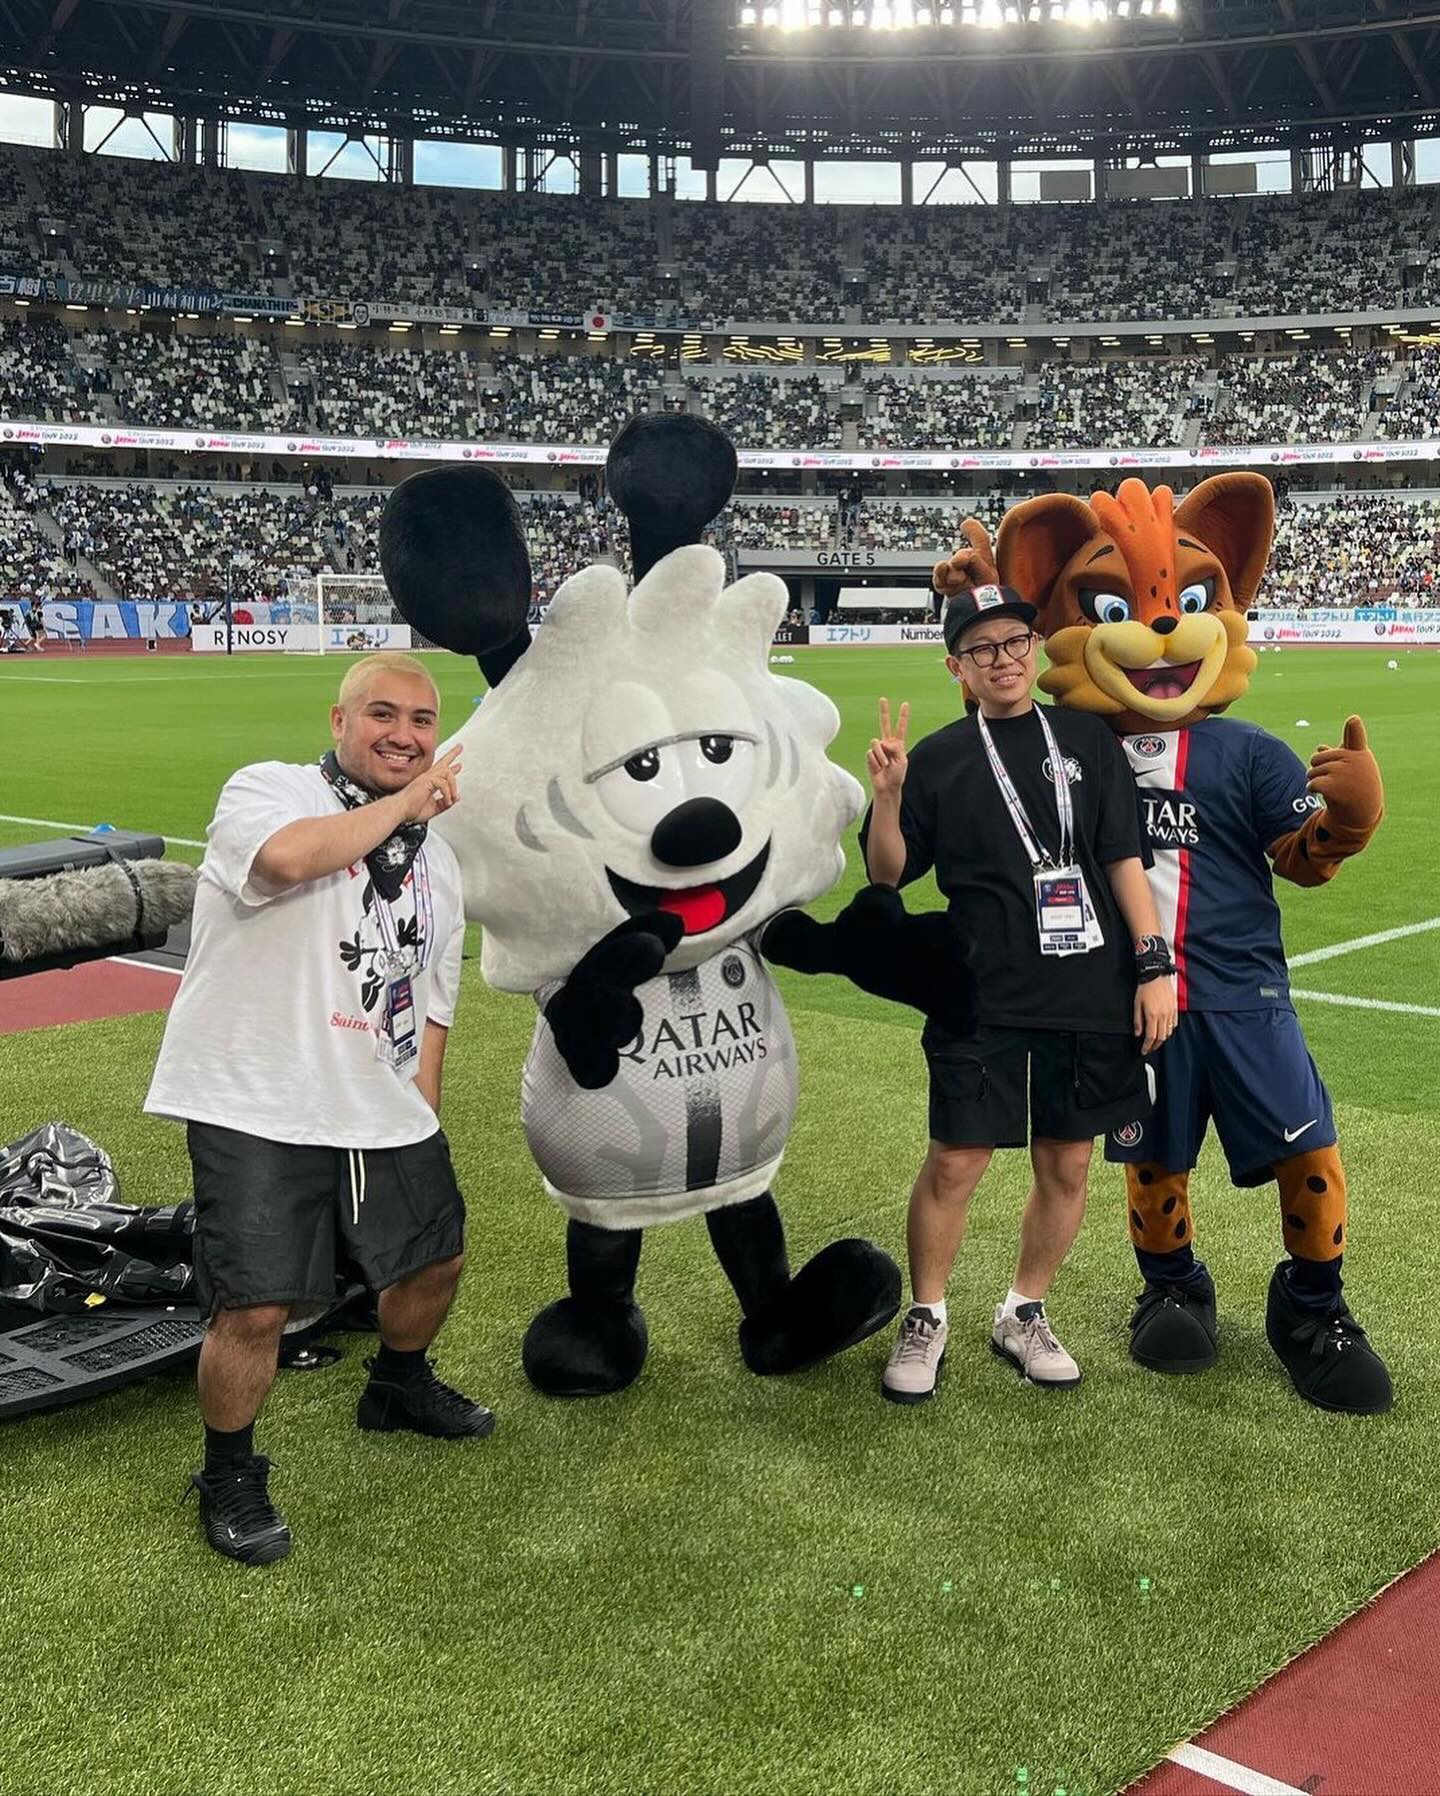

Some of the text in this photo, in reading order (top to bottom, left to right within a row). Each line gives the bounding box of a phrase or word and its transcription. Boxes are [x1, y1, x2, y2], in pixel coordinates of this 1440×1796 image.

[817, 552, 875, 566] GATE 5
[1143, 798, 1198, 828] TAR
[330, 1011, 369, 1032] Saint
[653, 1037, 768, 1080] AIRWAYS
